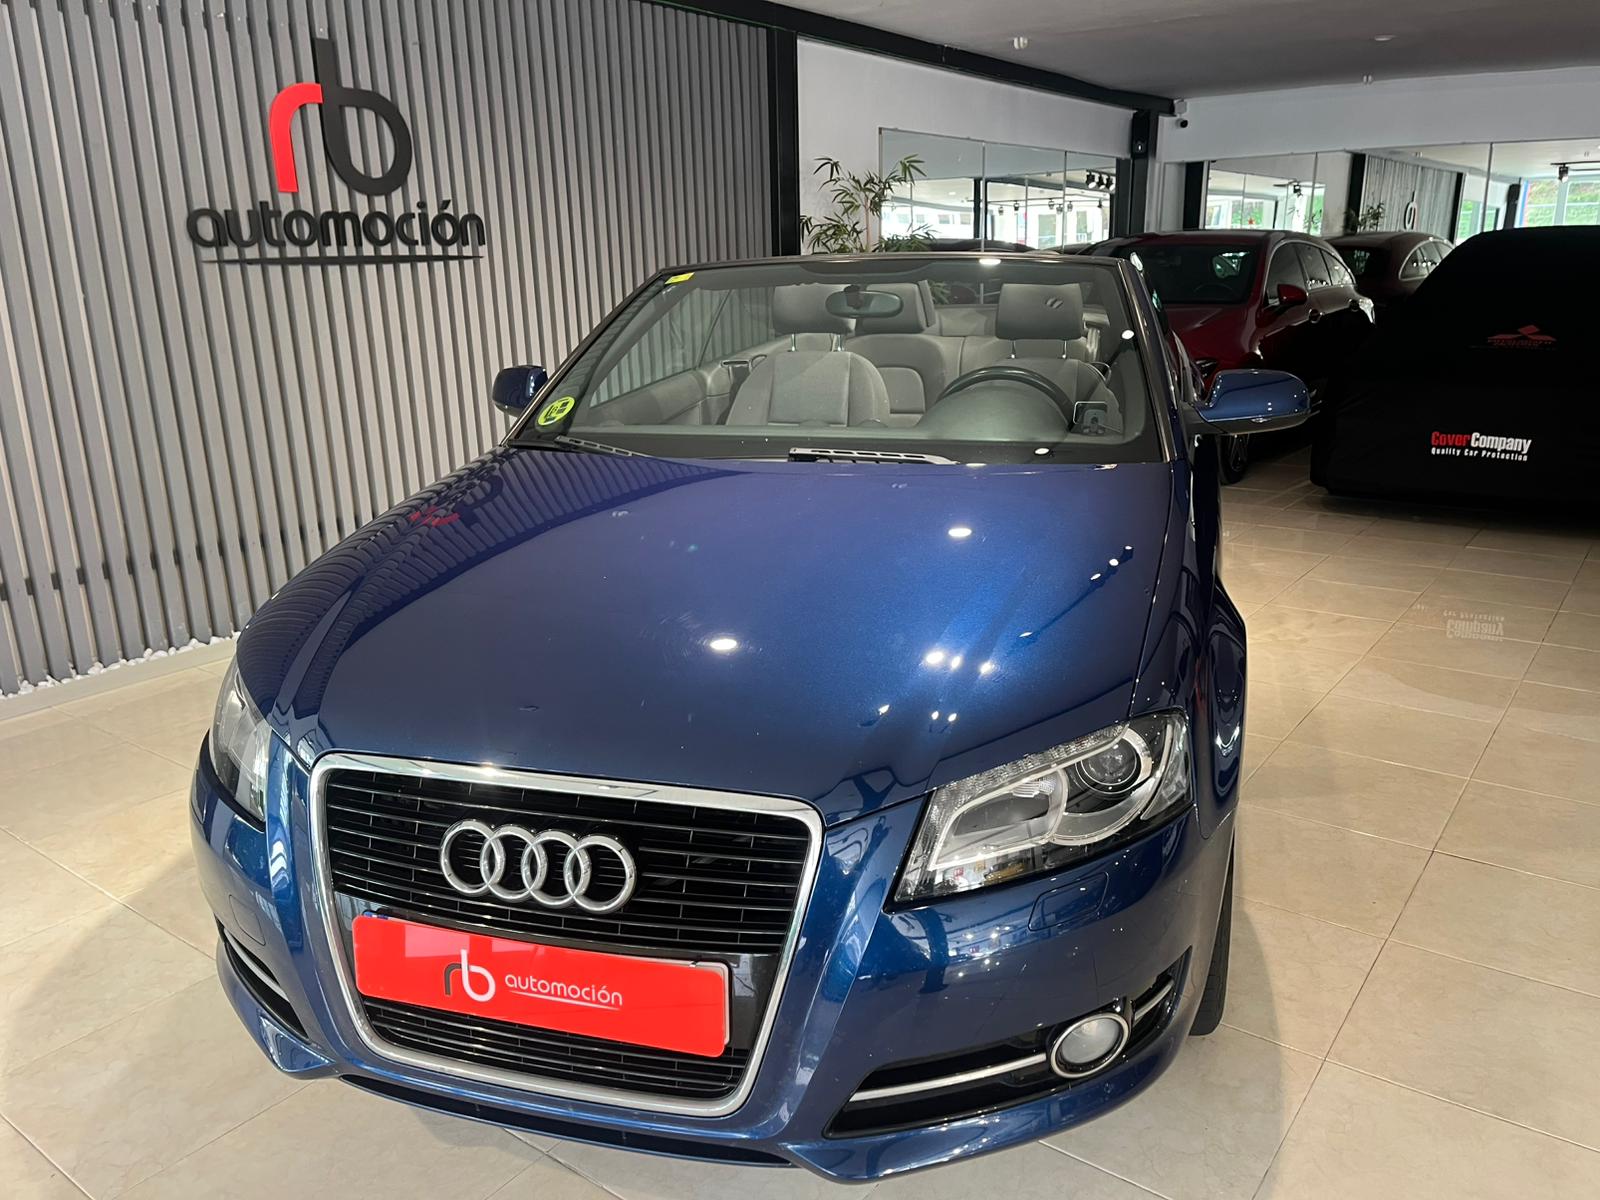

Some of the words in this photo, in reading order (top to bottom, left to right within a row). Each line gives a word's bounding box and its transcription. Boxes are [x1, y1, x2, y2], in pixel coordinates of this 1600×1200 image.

[186, 199, 486, 248] automoción
[1431, 447, 1461, 456] Quality
[1481, 450, 1528, 461] Protection
[504, 974, 623, 1006] automoción
